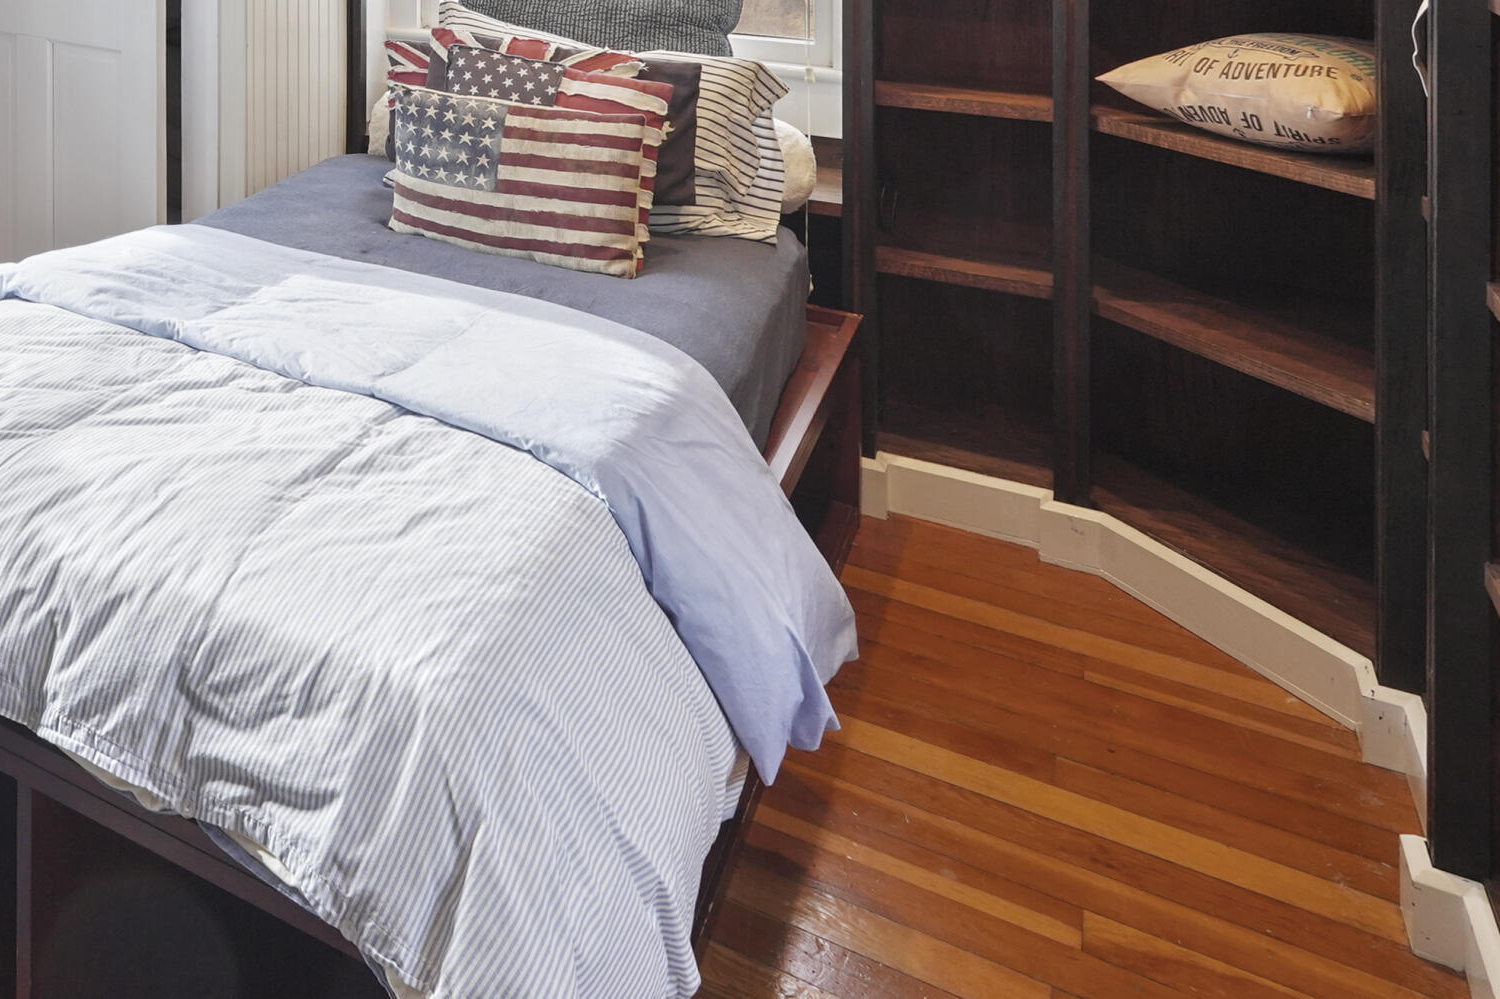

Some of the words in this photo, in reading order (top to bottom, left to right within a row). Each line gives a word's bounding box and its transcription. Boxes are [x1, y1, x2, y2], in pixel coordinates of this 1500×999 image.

[1193, 57, 1220, 76] OF
[1219, 61, 1340, 80] ADVENTURE
[1240, 111, 1264, 132] OF
[1273, 120, 1341, 145] SPIRIT
